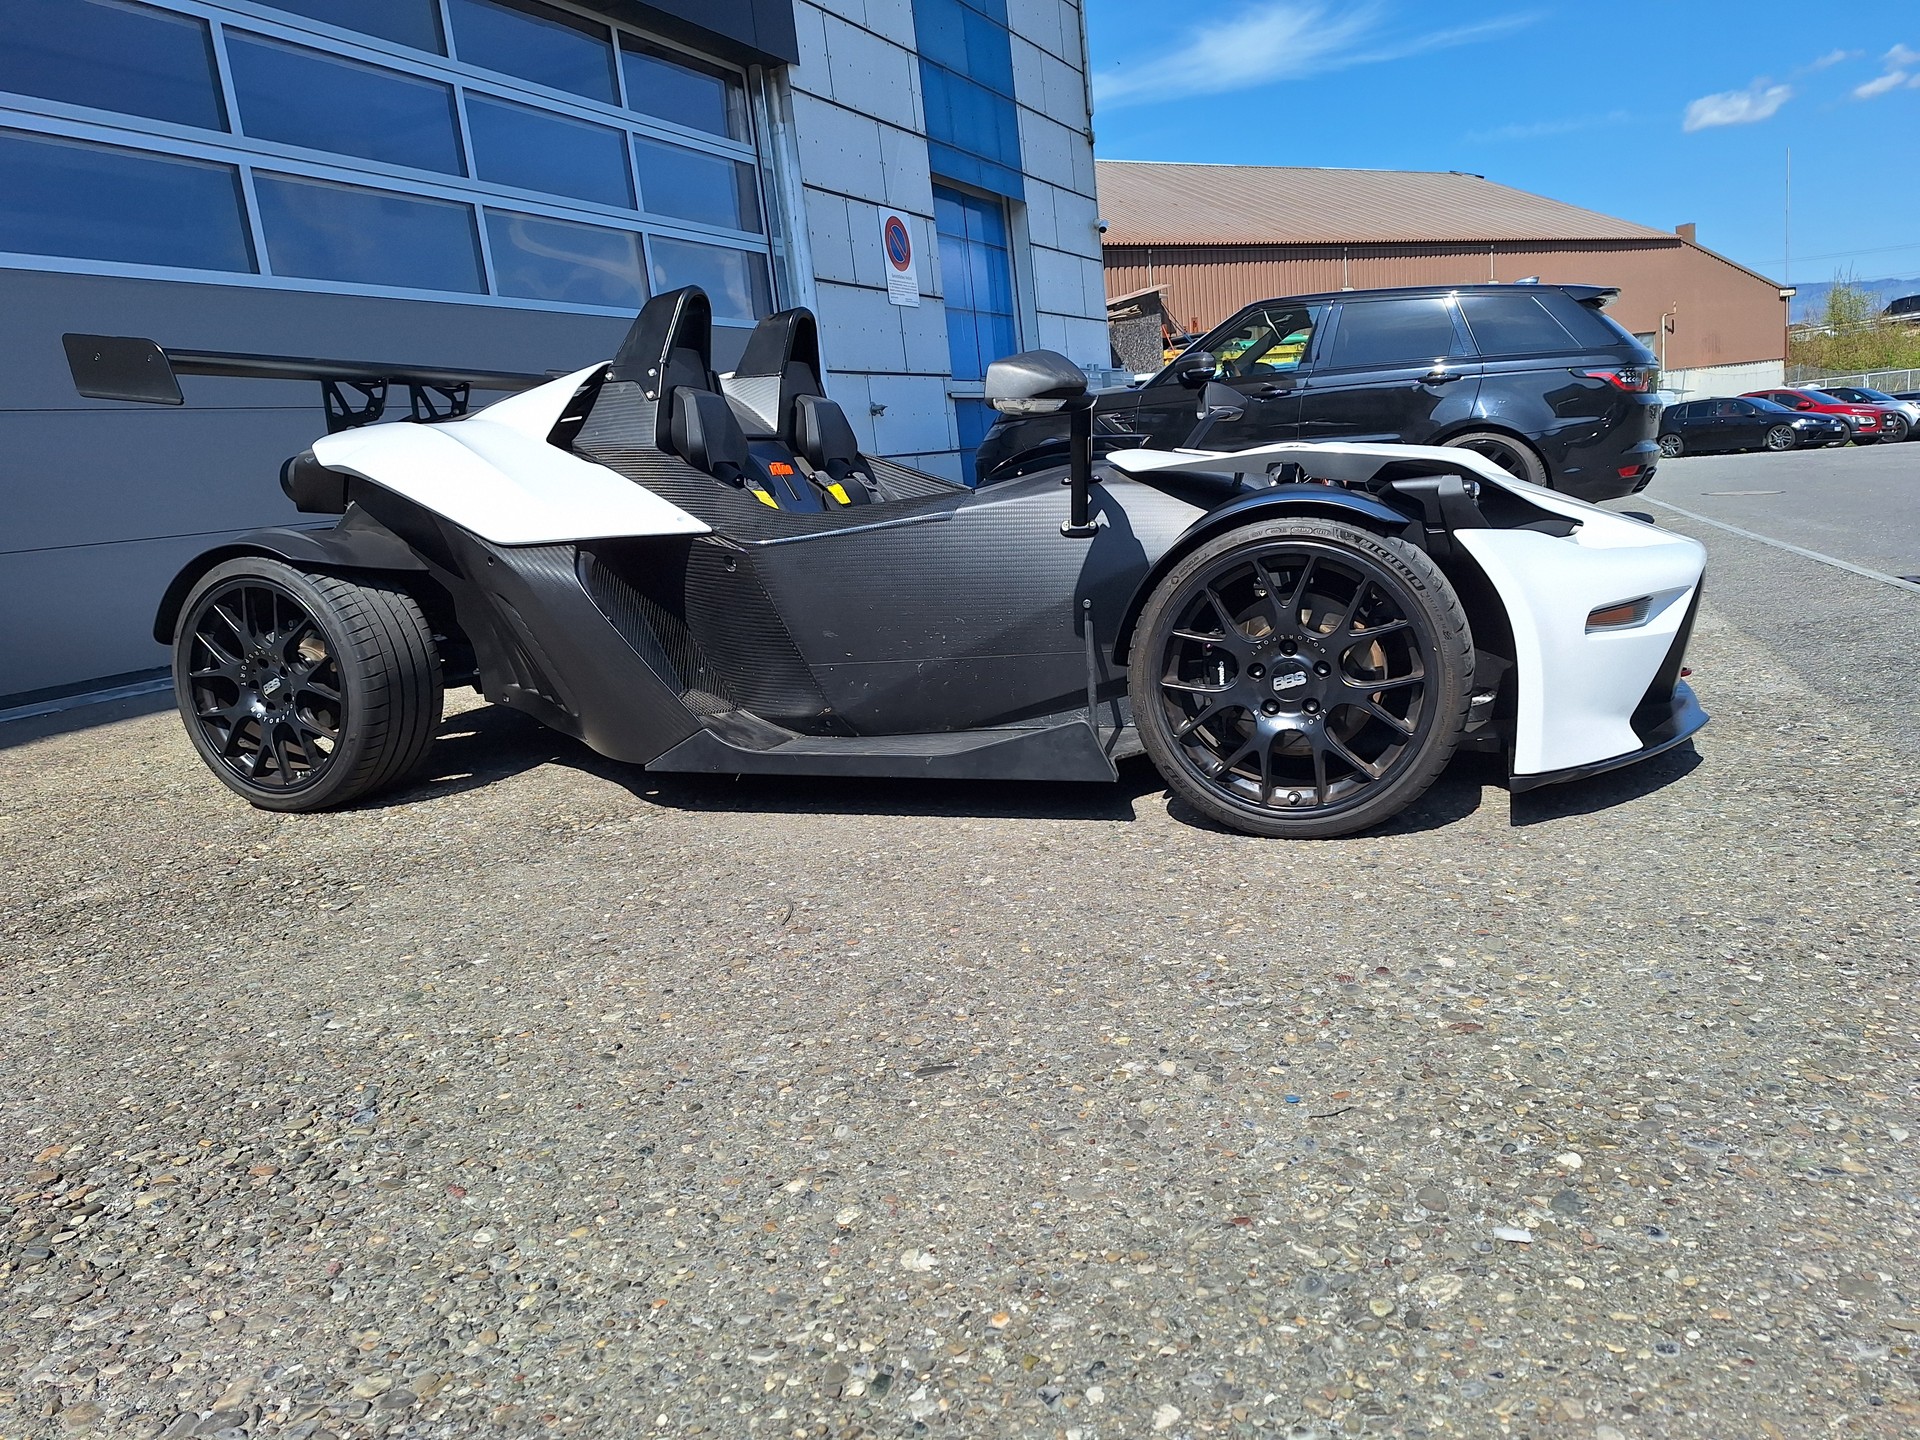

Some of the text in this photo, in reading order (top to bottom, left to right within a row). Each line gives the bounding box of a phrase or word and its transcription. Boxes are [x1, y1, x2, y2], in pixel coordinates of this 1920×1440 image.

[1360, 538, 1426, 592] MICHELIN
[1251, 634, 1327, 656] MOTORSPORT
[263, 677, 281, 695] BBS
[1273, 671, 1307, 691] BBS
[1252, 708, 1327, 728] MOTPORT
